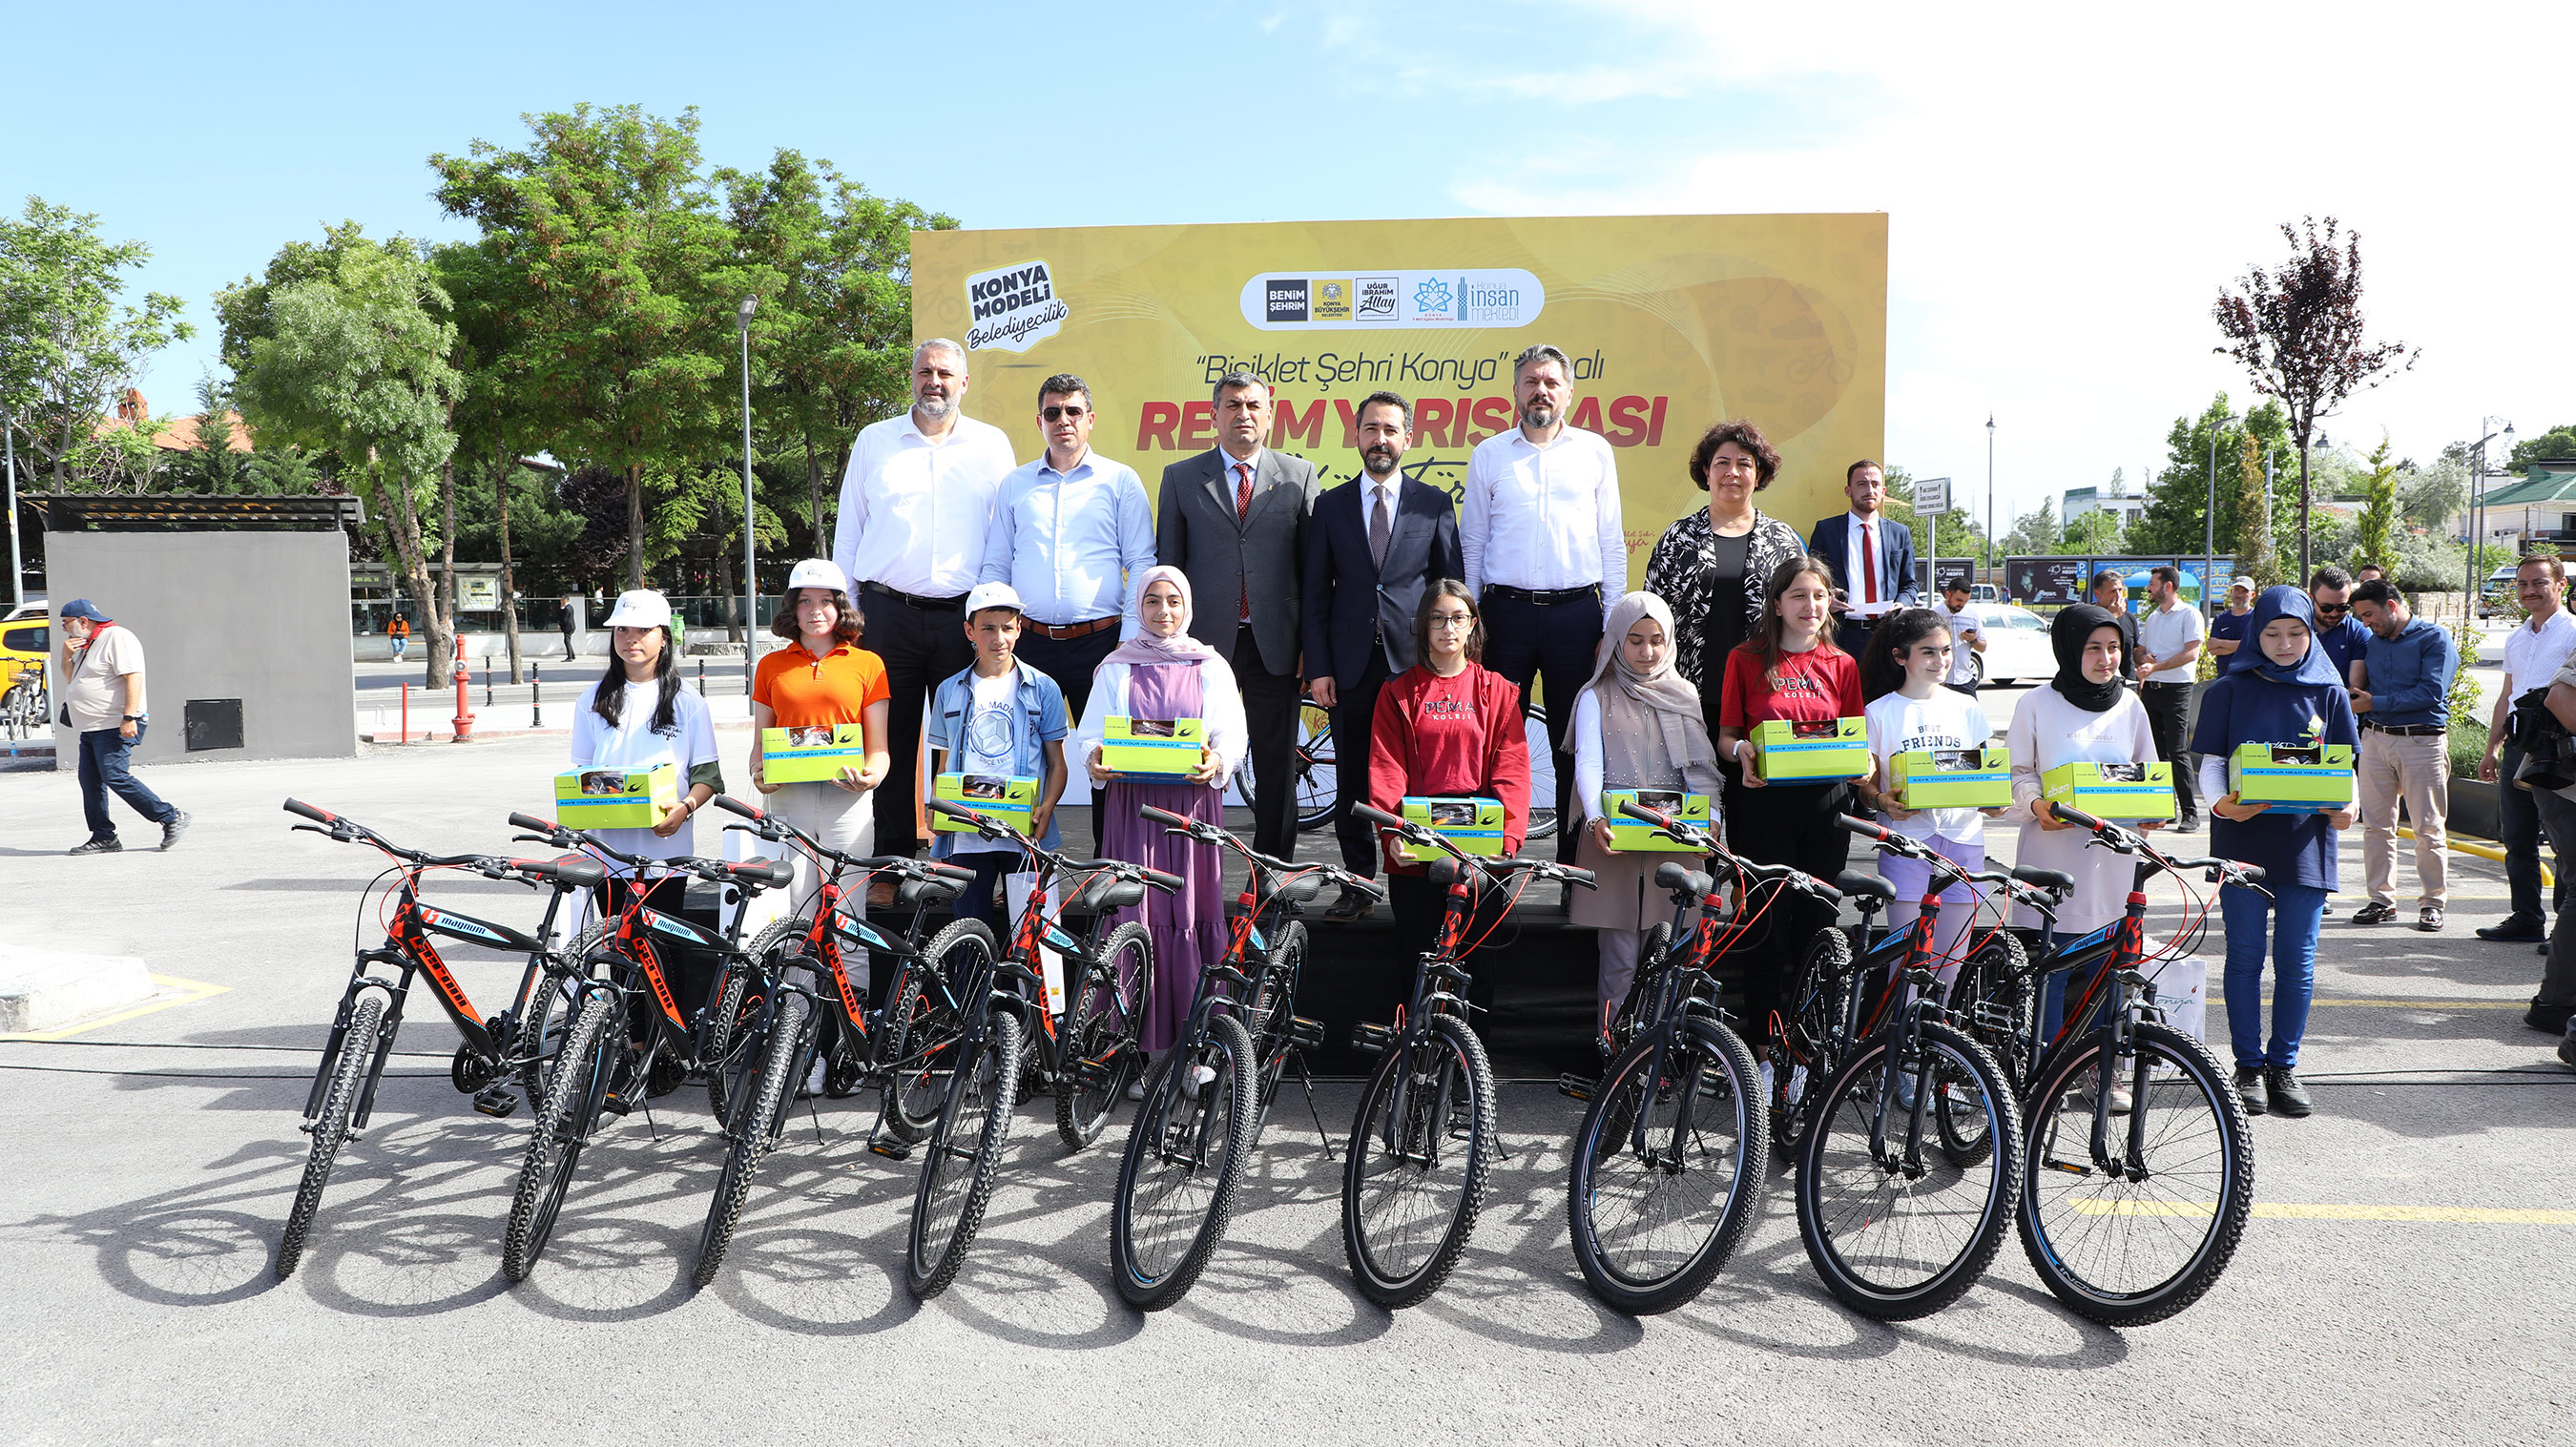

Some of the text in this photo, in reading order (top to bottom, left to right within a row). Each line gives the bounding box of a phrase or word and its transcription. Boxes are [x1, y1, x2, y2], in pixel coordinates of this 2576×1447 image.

[971, 265, 1049, 302] KONYA
[1359, 295, 1396, 314] Altay
[1470, 284, 1519, 307] insan
[966, 300, 1067, 349] Belediyecilik
[1315, 352, 1394, 392] Şehri
[1775, 676, 1825, 691] PEMA
[1424, 700, 1477, 714] PEMA
[1901, 735, 1962, 751] FRIENDS
[978, 755, 995, 766] SINCE
[441, 917, 487, 935] magnum
[657, 919, 692, 937] magnum
[2156, 998, 2195, 1013] onya
